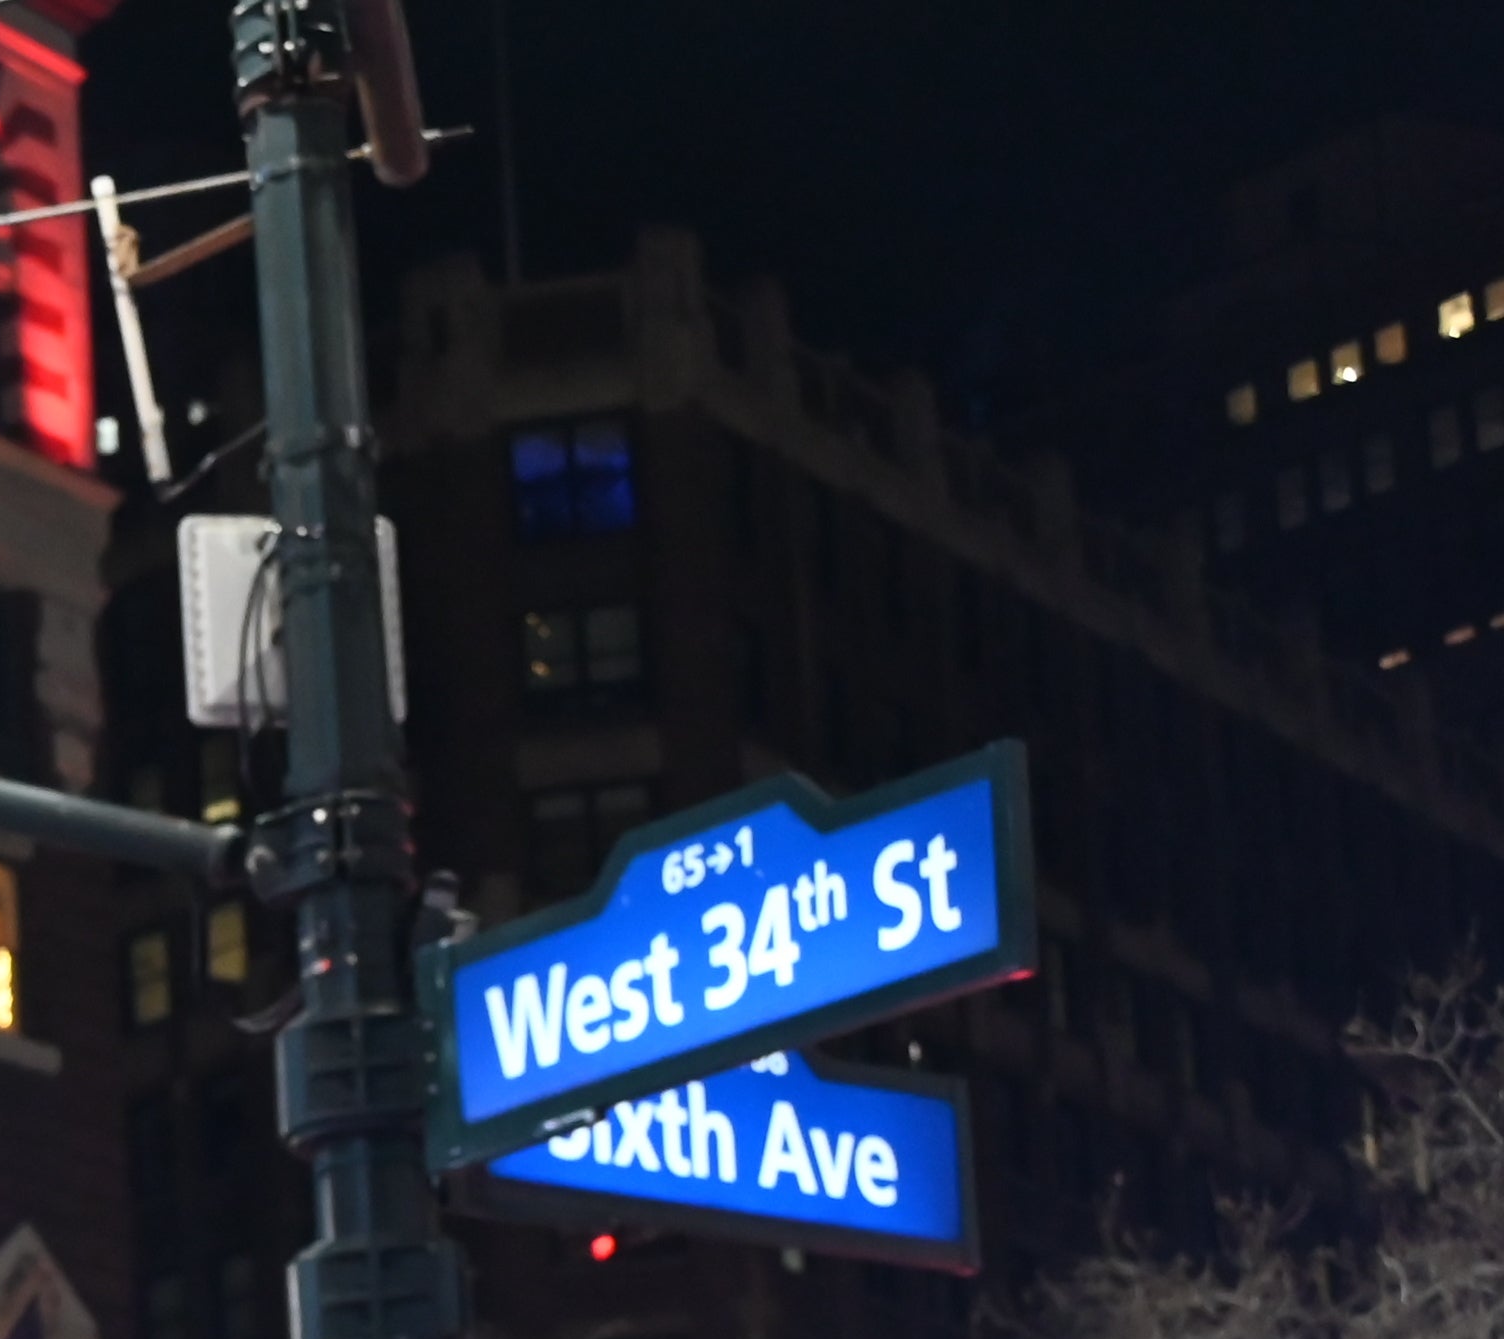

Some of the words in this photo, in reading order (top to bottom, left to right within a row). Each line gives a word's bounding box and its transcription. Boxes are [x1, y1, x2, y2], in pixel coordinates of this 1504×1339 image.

[484, 932, 684, 1079] West
[701, 858, 848, 1012] 34th
[872, 833, 962, 952] St
[758, 1099, 899, 1208] Ave
